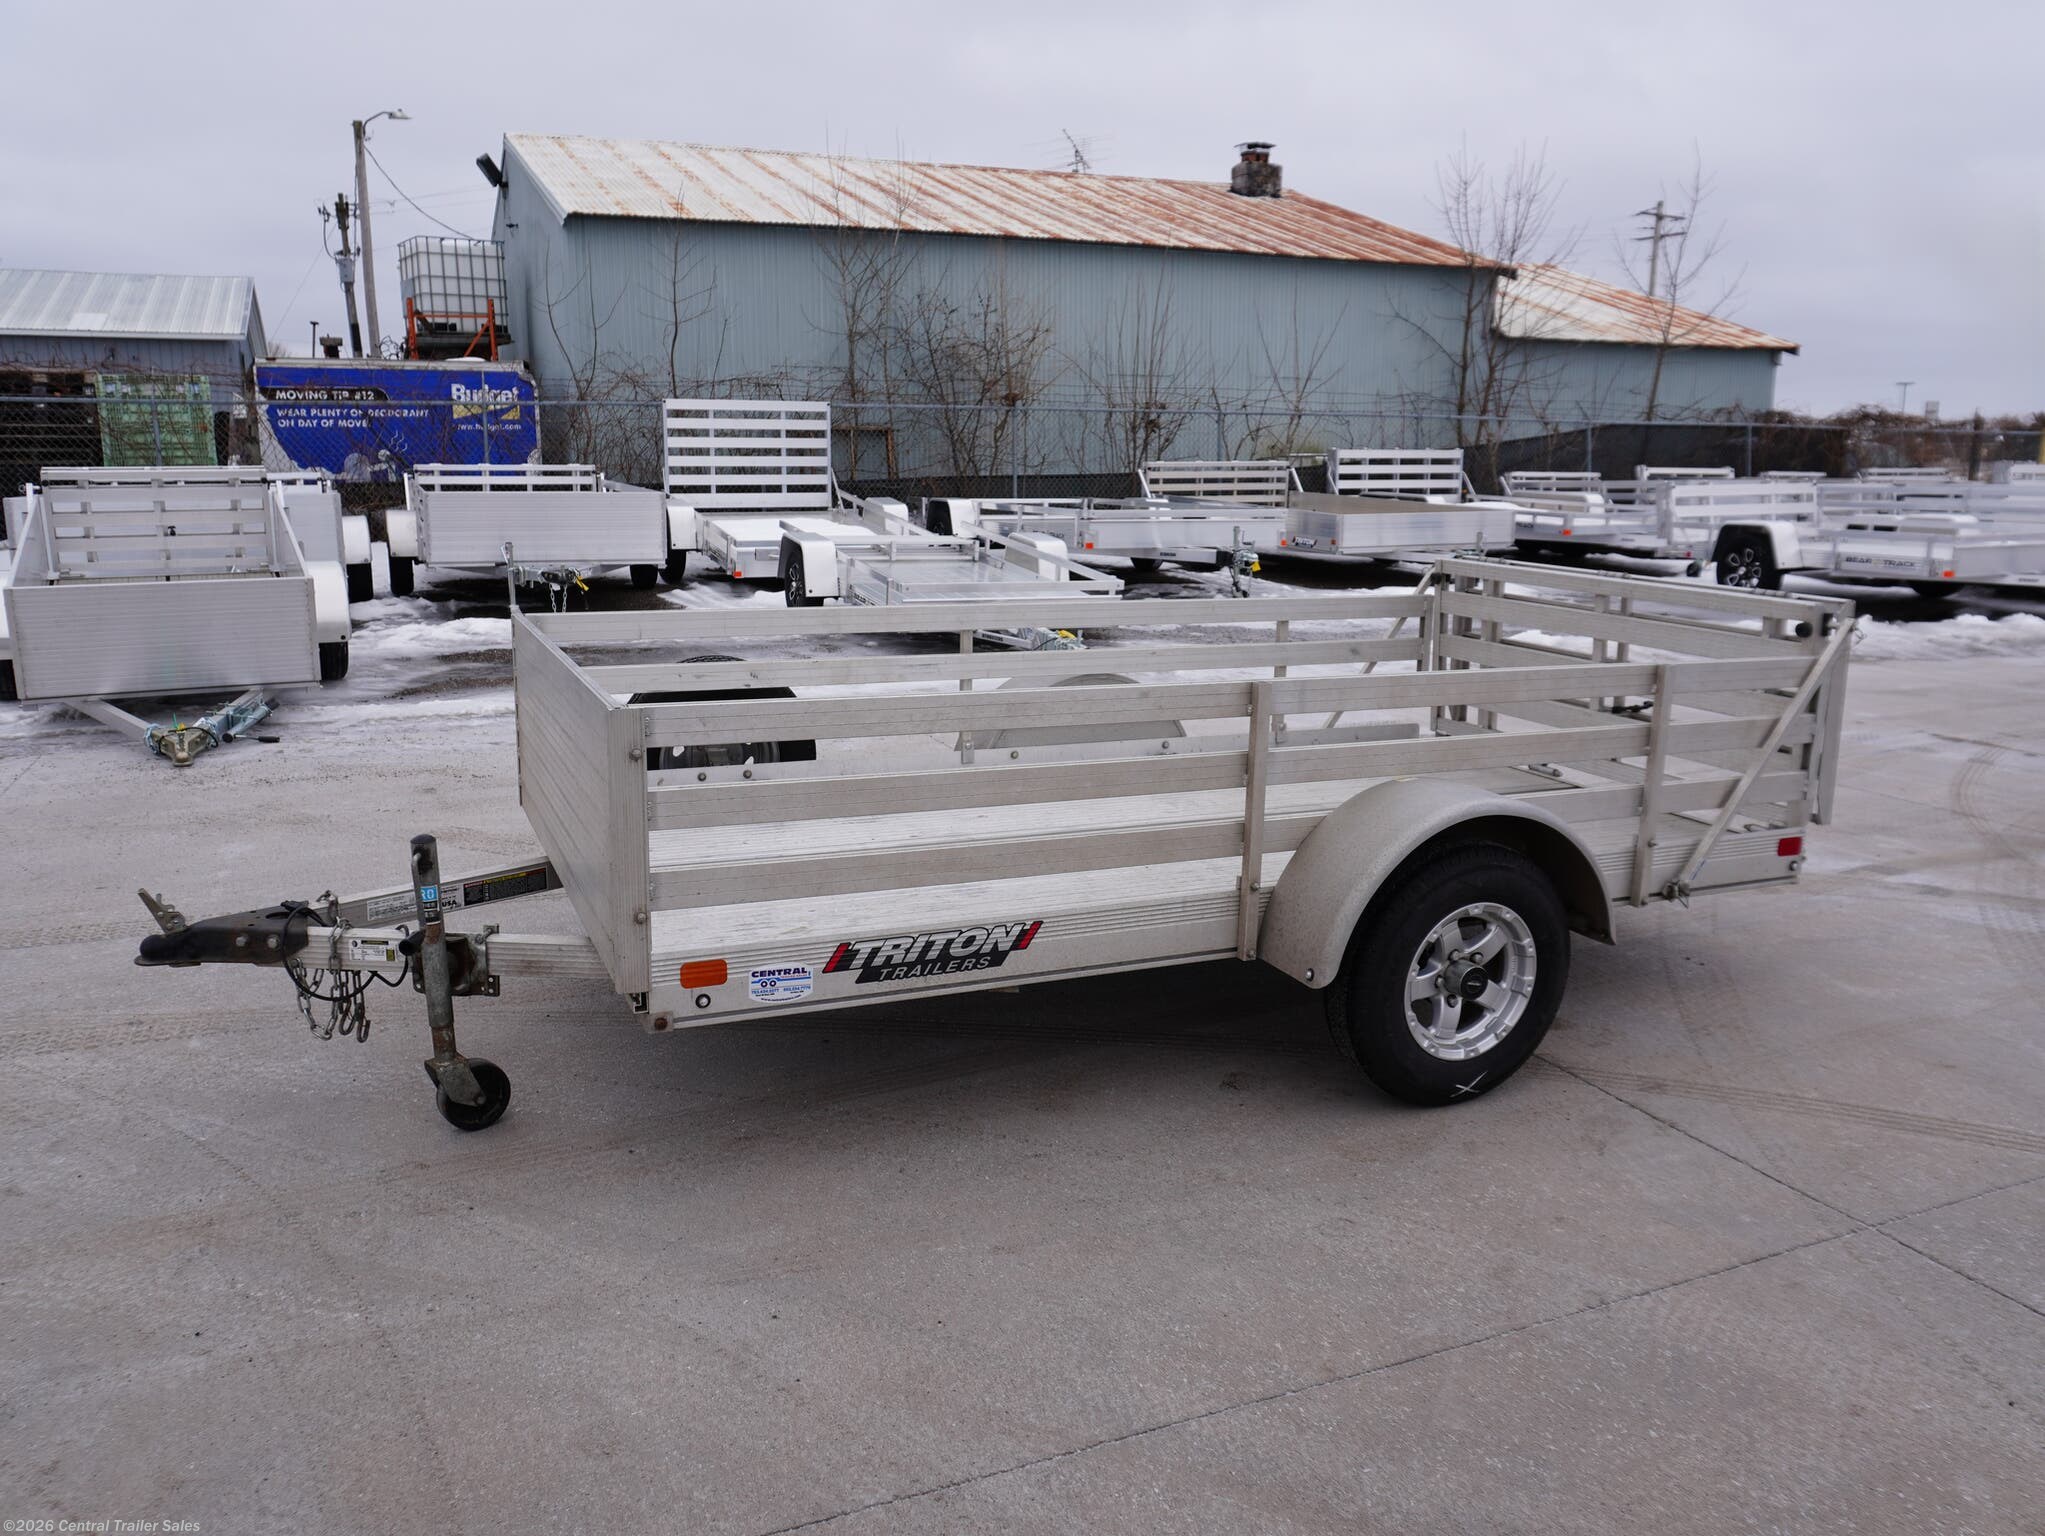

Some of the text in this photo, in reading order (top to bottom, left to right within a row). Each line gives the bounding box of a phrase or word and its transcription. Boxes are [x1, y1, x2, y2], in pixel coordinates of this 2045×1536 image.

[275, 390, 328, 400] MOVING
[354, 390, 375, 400] #12
[451, 384, 519, 405] Budget
[276, 408, 307, 417] WEAR
[310, 408, 348, 417] PLENTY
[277, 419, 295, 428] ON
[298, 419, 317, 428] DAY
[321, 419, 334, 428] OF
[849, 922, 1026, 969] TRITON
[751, 967, 807, 978] CENTRAL
[879, 956, 991, 982] TRAILERS
